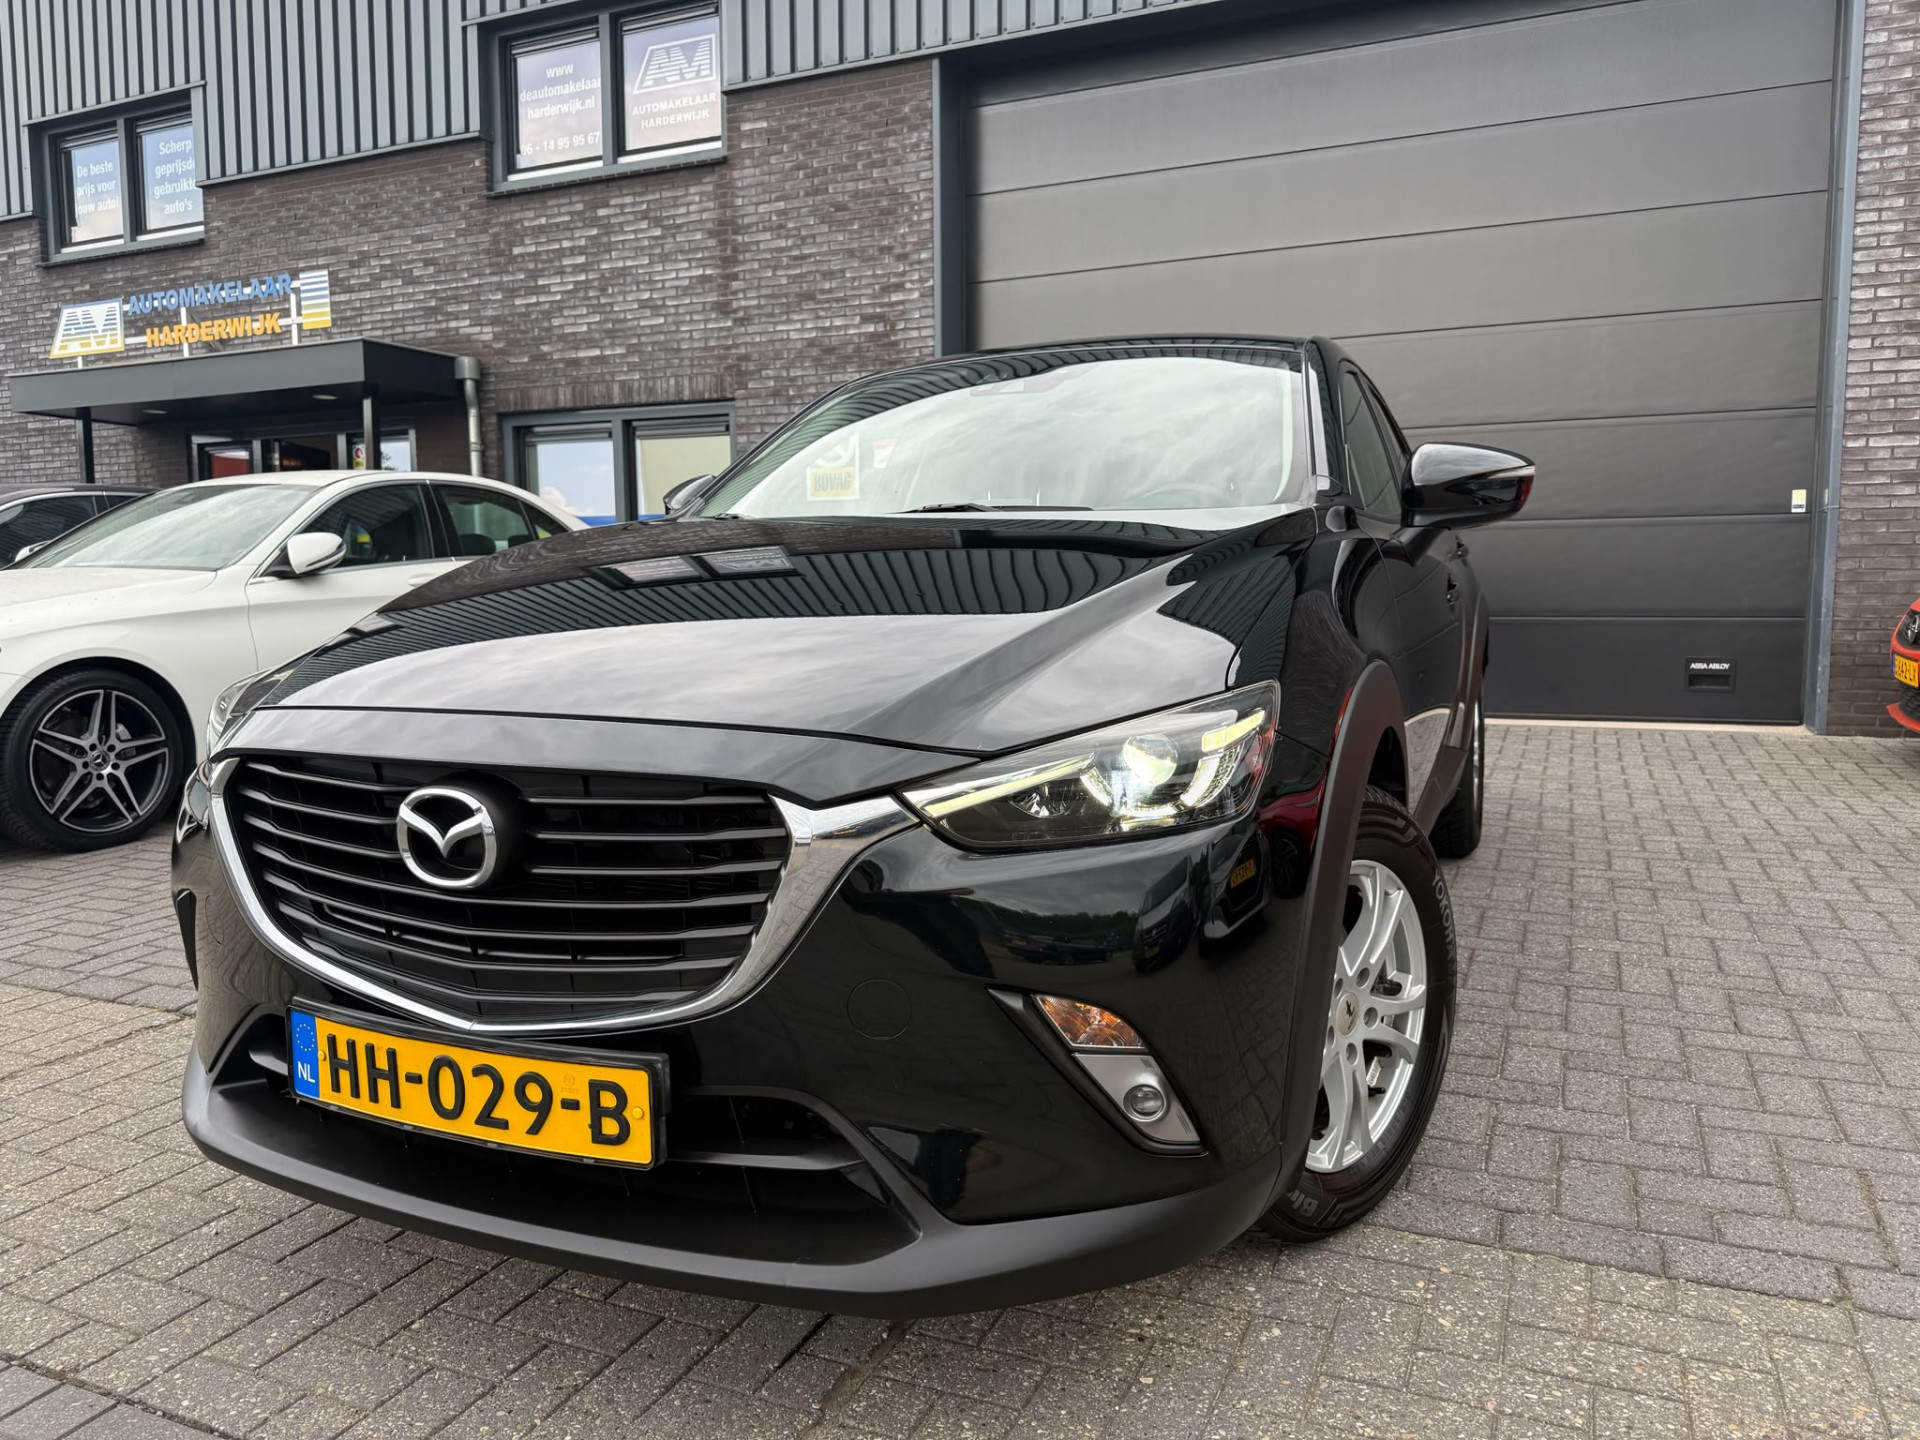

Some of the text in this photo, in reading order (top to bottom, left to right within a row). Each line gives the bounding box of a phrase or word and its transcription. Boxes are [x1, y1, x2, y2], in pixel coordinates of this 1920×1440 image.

[545, 64, 574, 79] www
[527, 95, 595, 120] harderwijk.nl
[632, 93, 716, 116] AUTOMAKELAAR
[641, 109, 710, 129] HARDERWIJK
[159, 140, 192, 155] Scherp
[543, 139, 555, 152] 14
[557, 136, 570, 150] 95
[572, 134, 585, 147] 95
[588, 132, 600, 145] 67
[77, 161, 114, 177] De beste
[76, 180, 116, 197] prijs voor
[164, 199, 193, 215] auto's
[128, 273, 292, 316] AUTOMAKELAAR
[146, 312, 282, 348] HARDERWIJK
[814, 472, 852, 493] BOVAG
[1690, 662, 1731, 670] ASSA ABLOY
[297, 1060, 316, 1084] NL
[327, 1033, 631, 1146] HH-029-B
